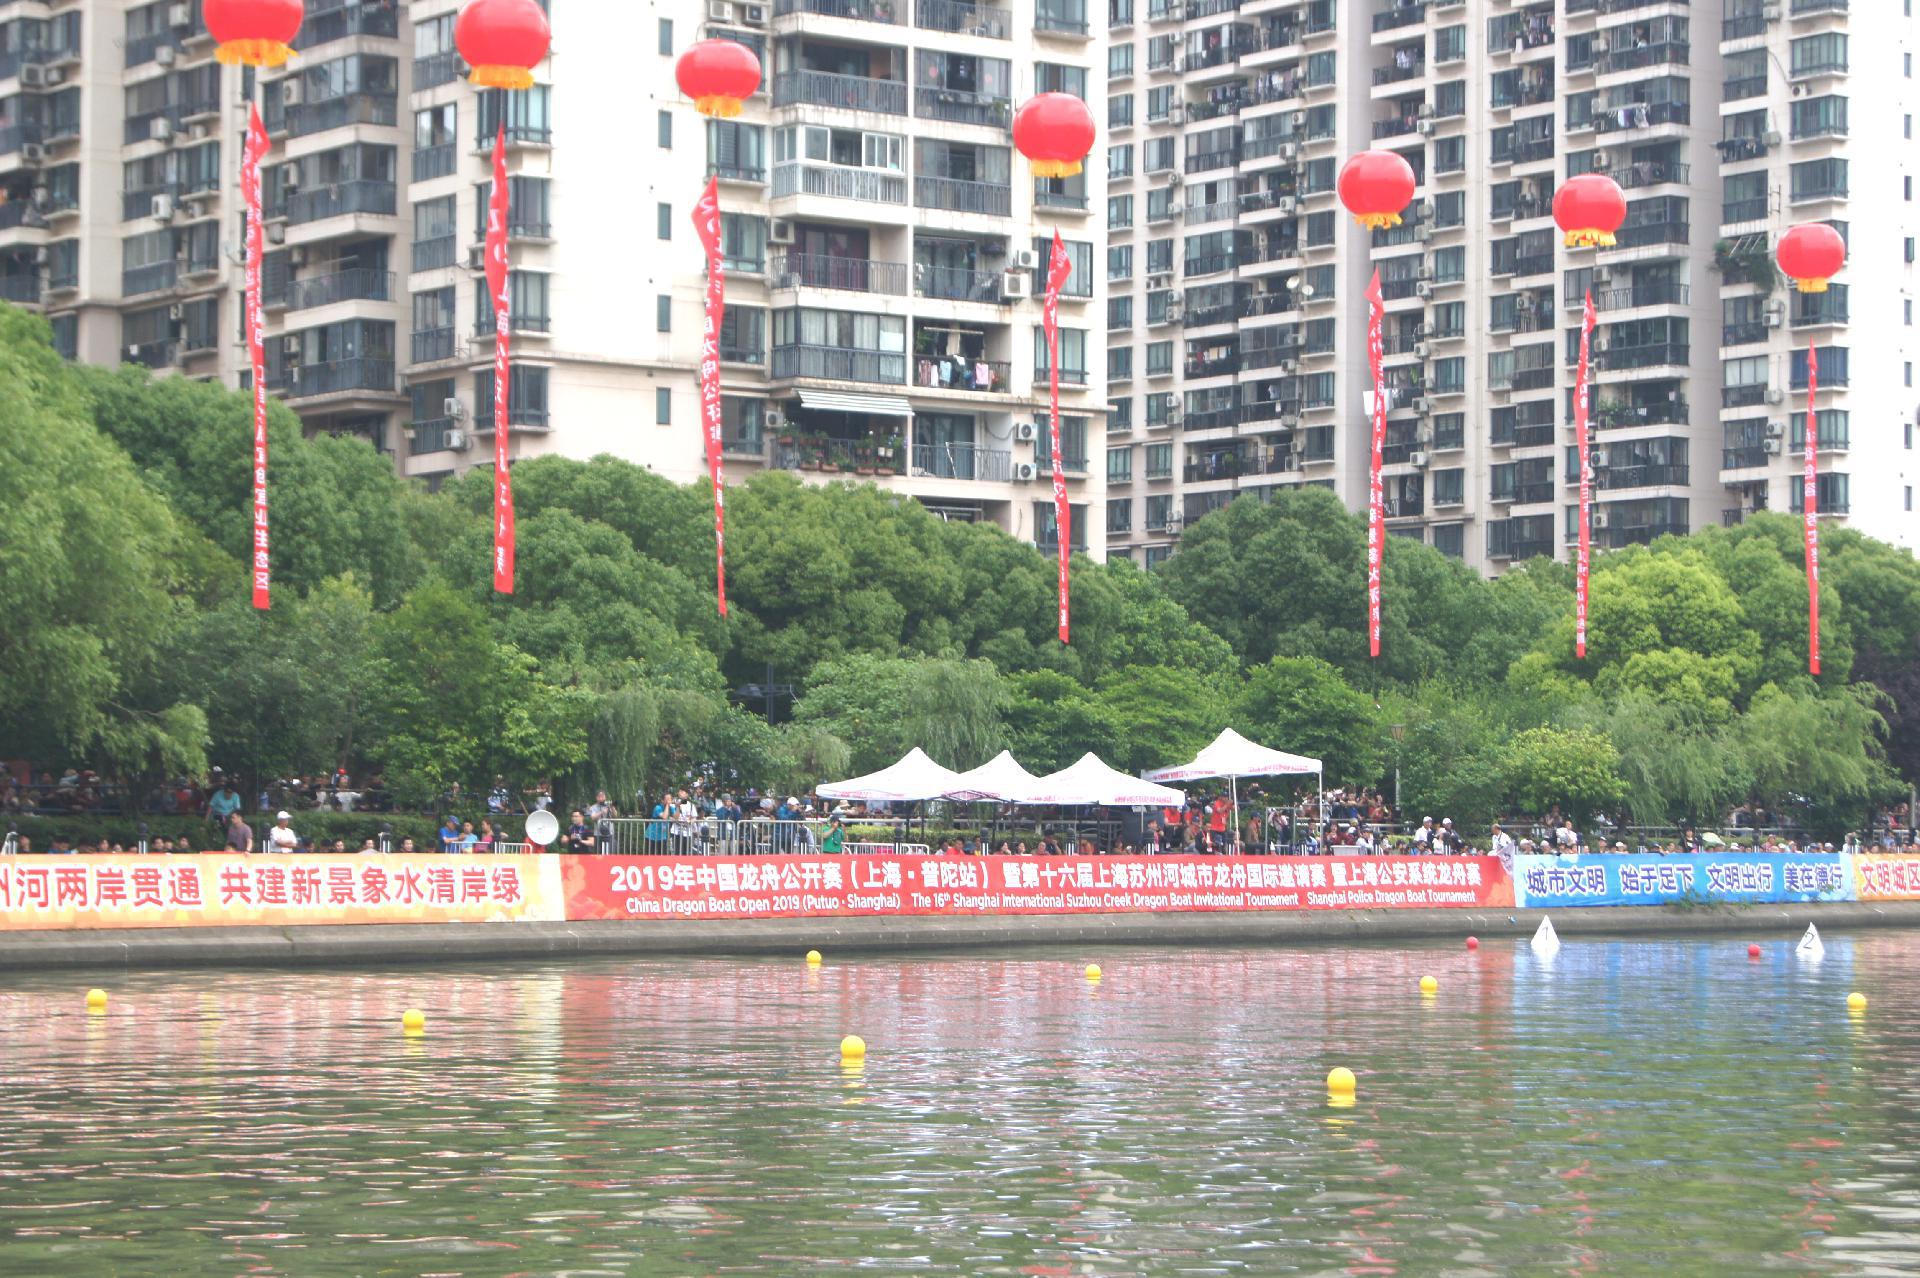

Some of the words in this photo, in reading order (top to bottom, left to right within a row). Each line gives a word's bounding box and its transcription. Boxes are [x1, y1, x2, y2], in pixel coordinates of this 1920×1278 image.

[221, 866, 521, 905] 共建新景象水清岸绿
[1003, 862, 1327, 888] 暨第十六届上海苏州河城市龙舟国际邀请赛
[1331, 861, 1482, 887] 暨上海公安系统龙舟赛
[1527, 867, 1605, 894] 城市文明
[1620, 866, 1693, 892] 始于足下
[1708, 864, 1772, 890] 文明出行
[1784, 865, 1843, 890] 美在德行
[626, 897, 660, 913] China
[663, 898, 705, 915] Dragon
[708, 897, 737, 912] Boat
[738, 897, 770, 915] Open
[773, 895, 800, 911] 2019
[802, 894, 839, 911] (Putuo
[847, 893, 900, 910] Shanghai)
[911, 893, 931, 907] The
[953, 893, 1000, 910] Shanghai
[1002, 892, 1064, 908] International
[1066, 892, 1101, 907] Suzhou
[1103, 892, 1131, 906] Creek
[1133, 893, 1168, 909] Dragon
[1170, 892, 1192, 906] Boat
[1194, 891, 1243, 906] Invitational
[1245, 891, 1299, 906] Tournament
[1307, 890, 1346, 907] Shanghai
[1348, 890, 1374, 904] Police
[1376, 890, 1405, 905] Dragon
[1407, 889, 1426, 903] Boat
[1428, 889, 1476, 903] Tournament
[1803, 931, 1815, 949] 2
